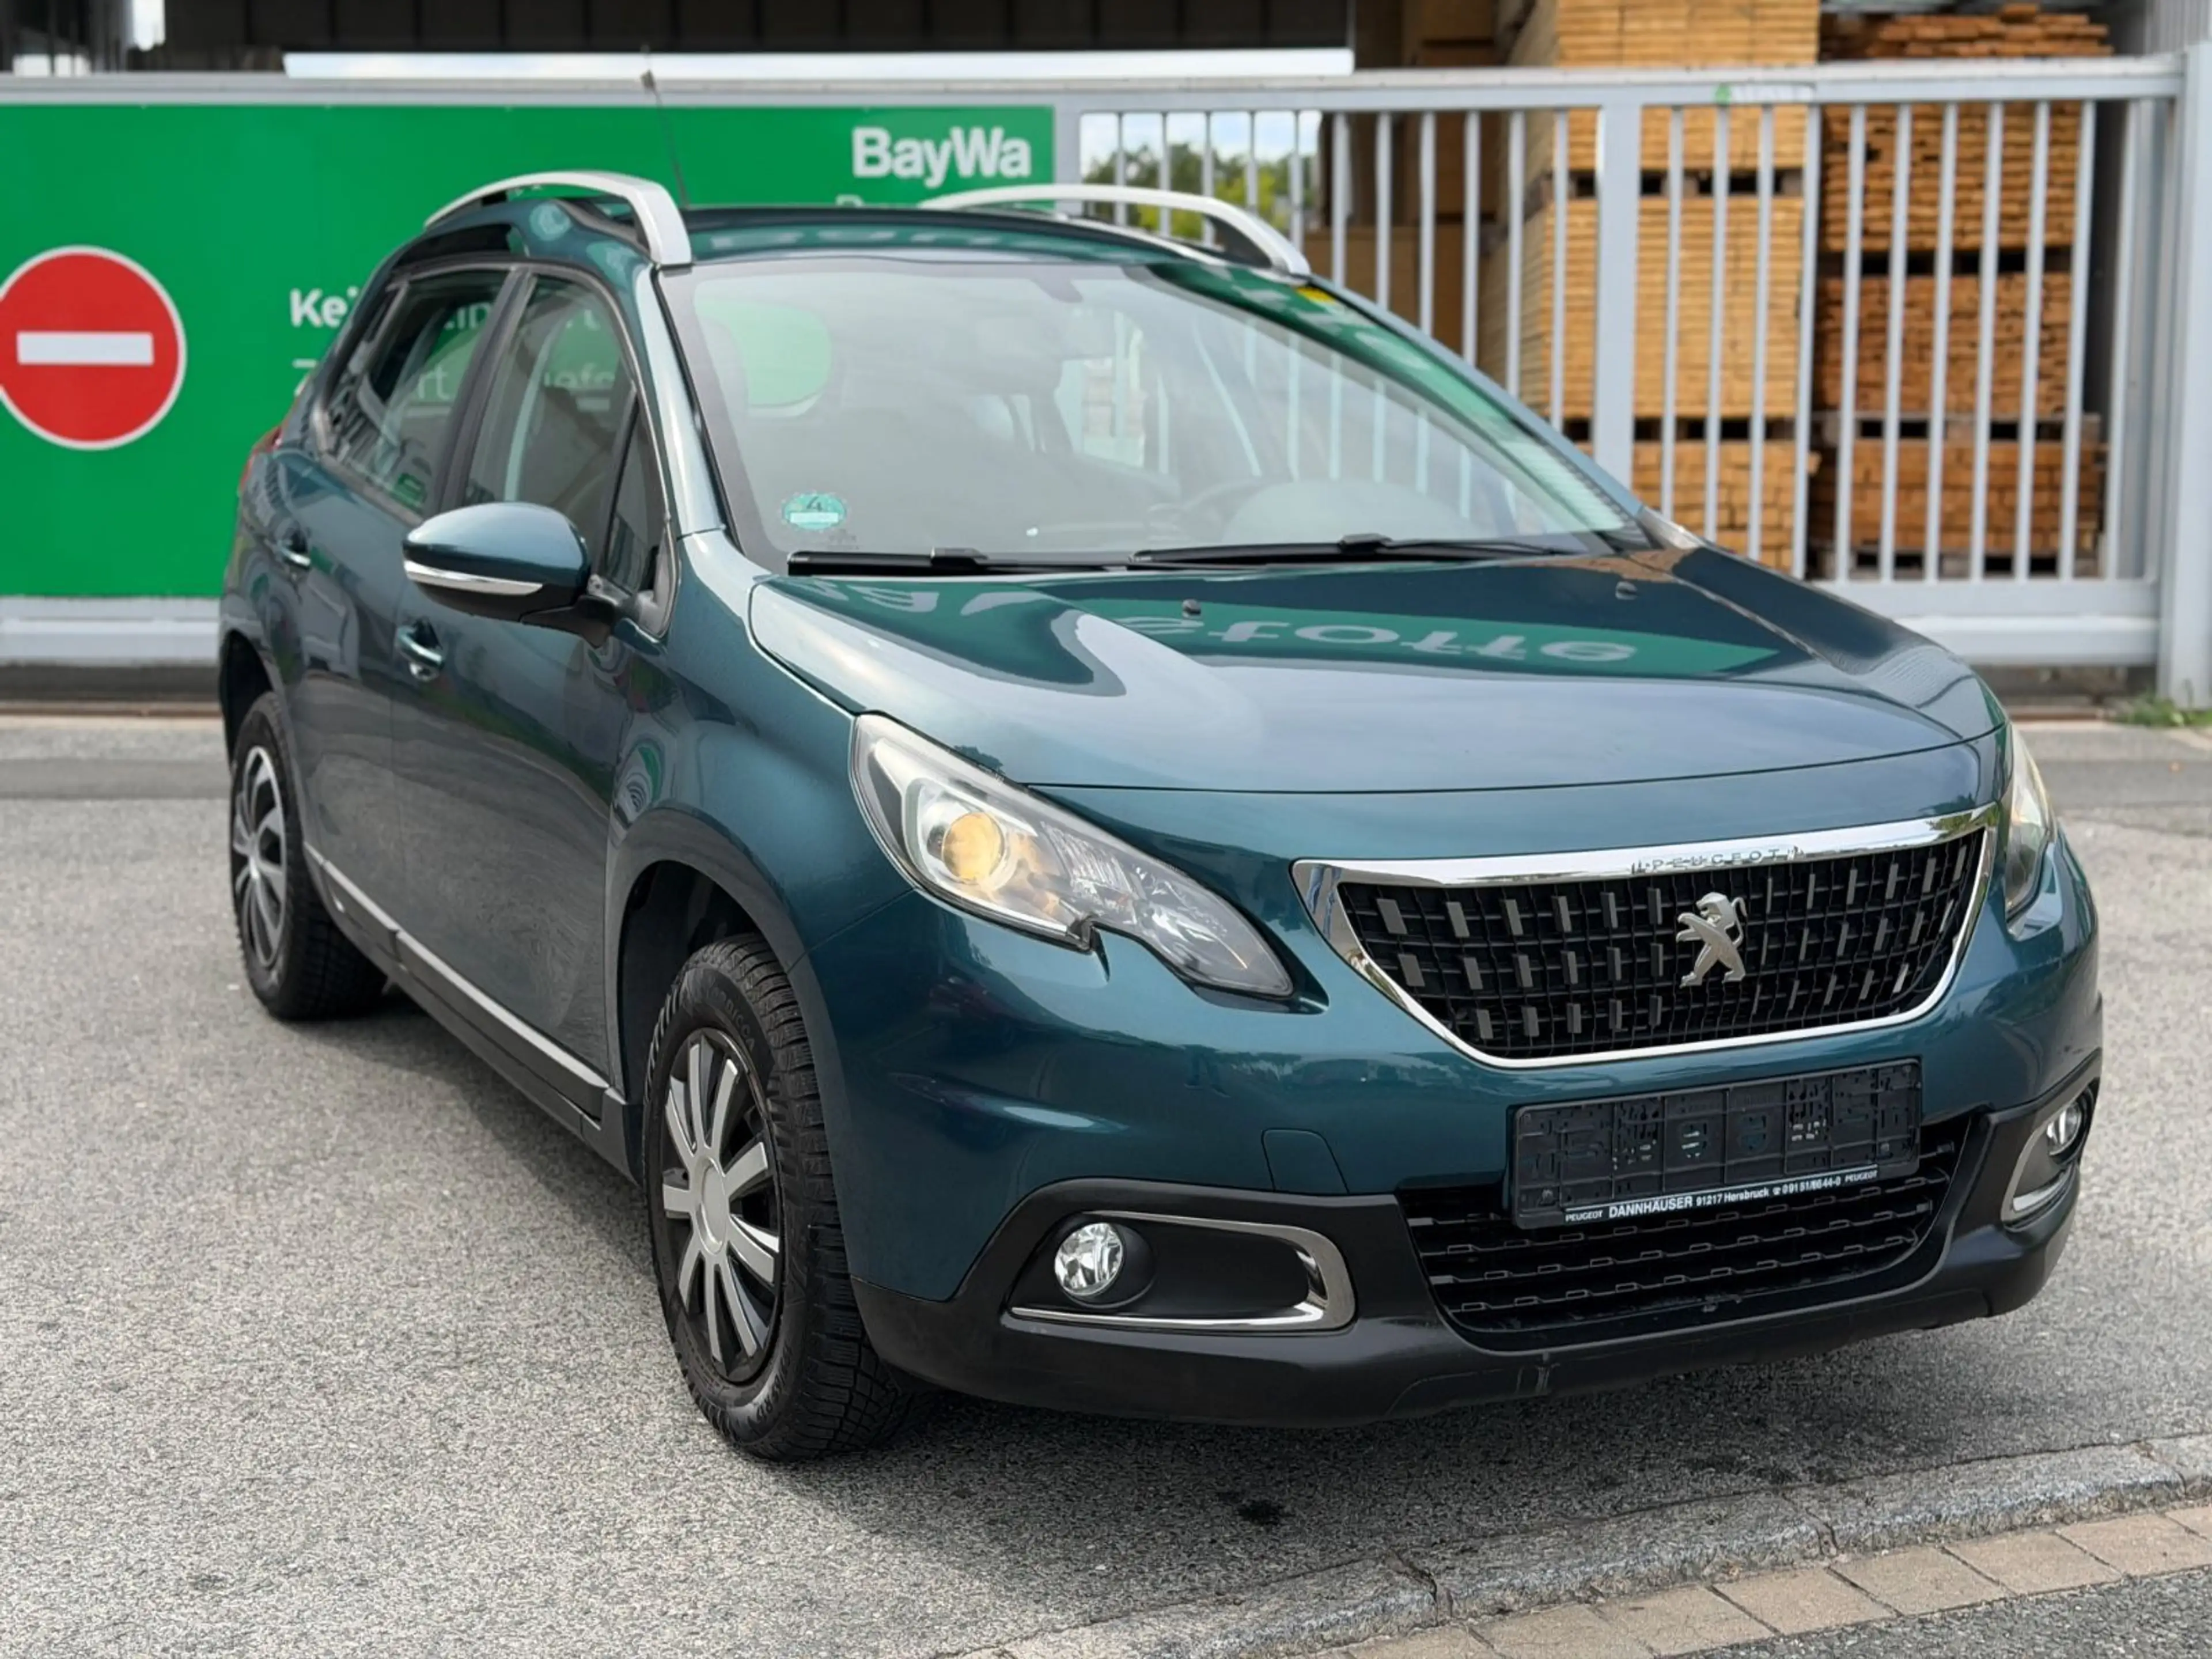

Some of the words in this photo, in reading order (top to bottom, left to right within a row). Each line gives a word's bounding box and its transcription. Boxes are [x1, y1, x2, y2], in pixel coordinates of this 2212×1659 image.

[852, 126, 1032, 189] BayWa
[1565, 1210, 1603, 1222] PEUGEOT
[1696, 1193, 1722, 1206] 91217
